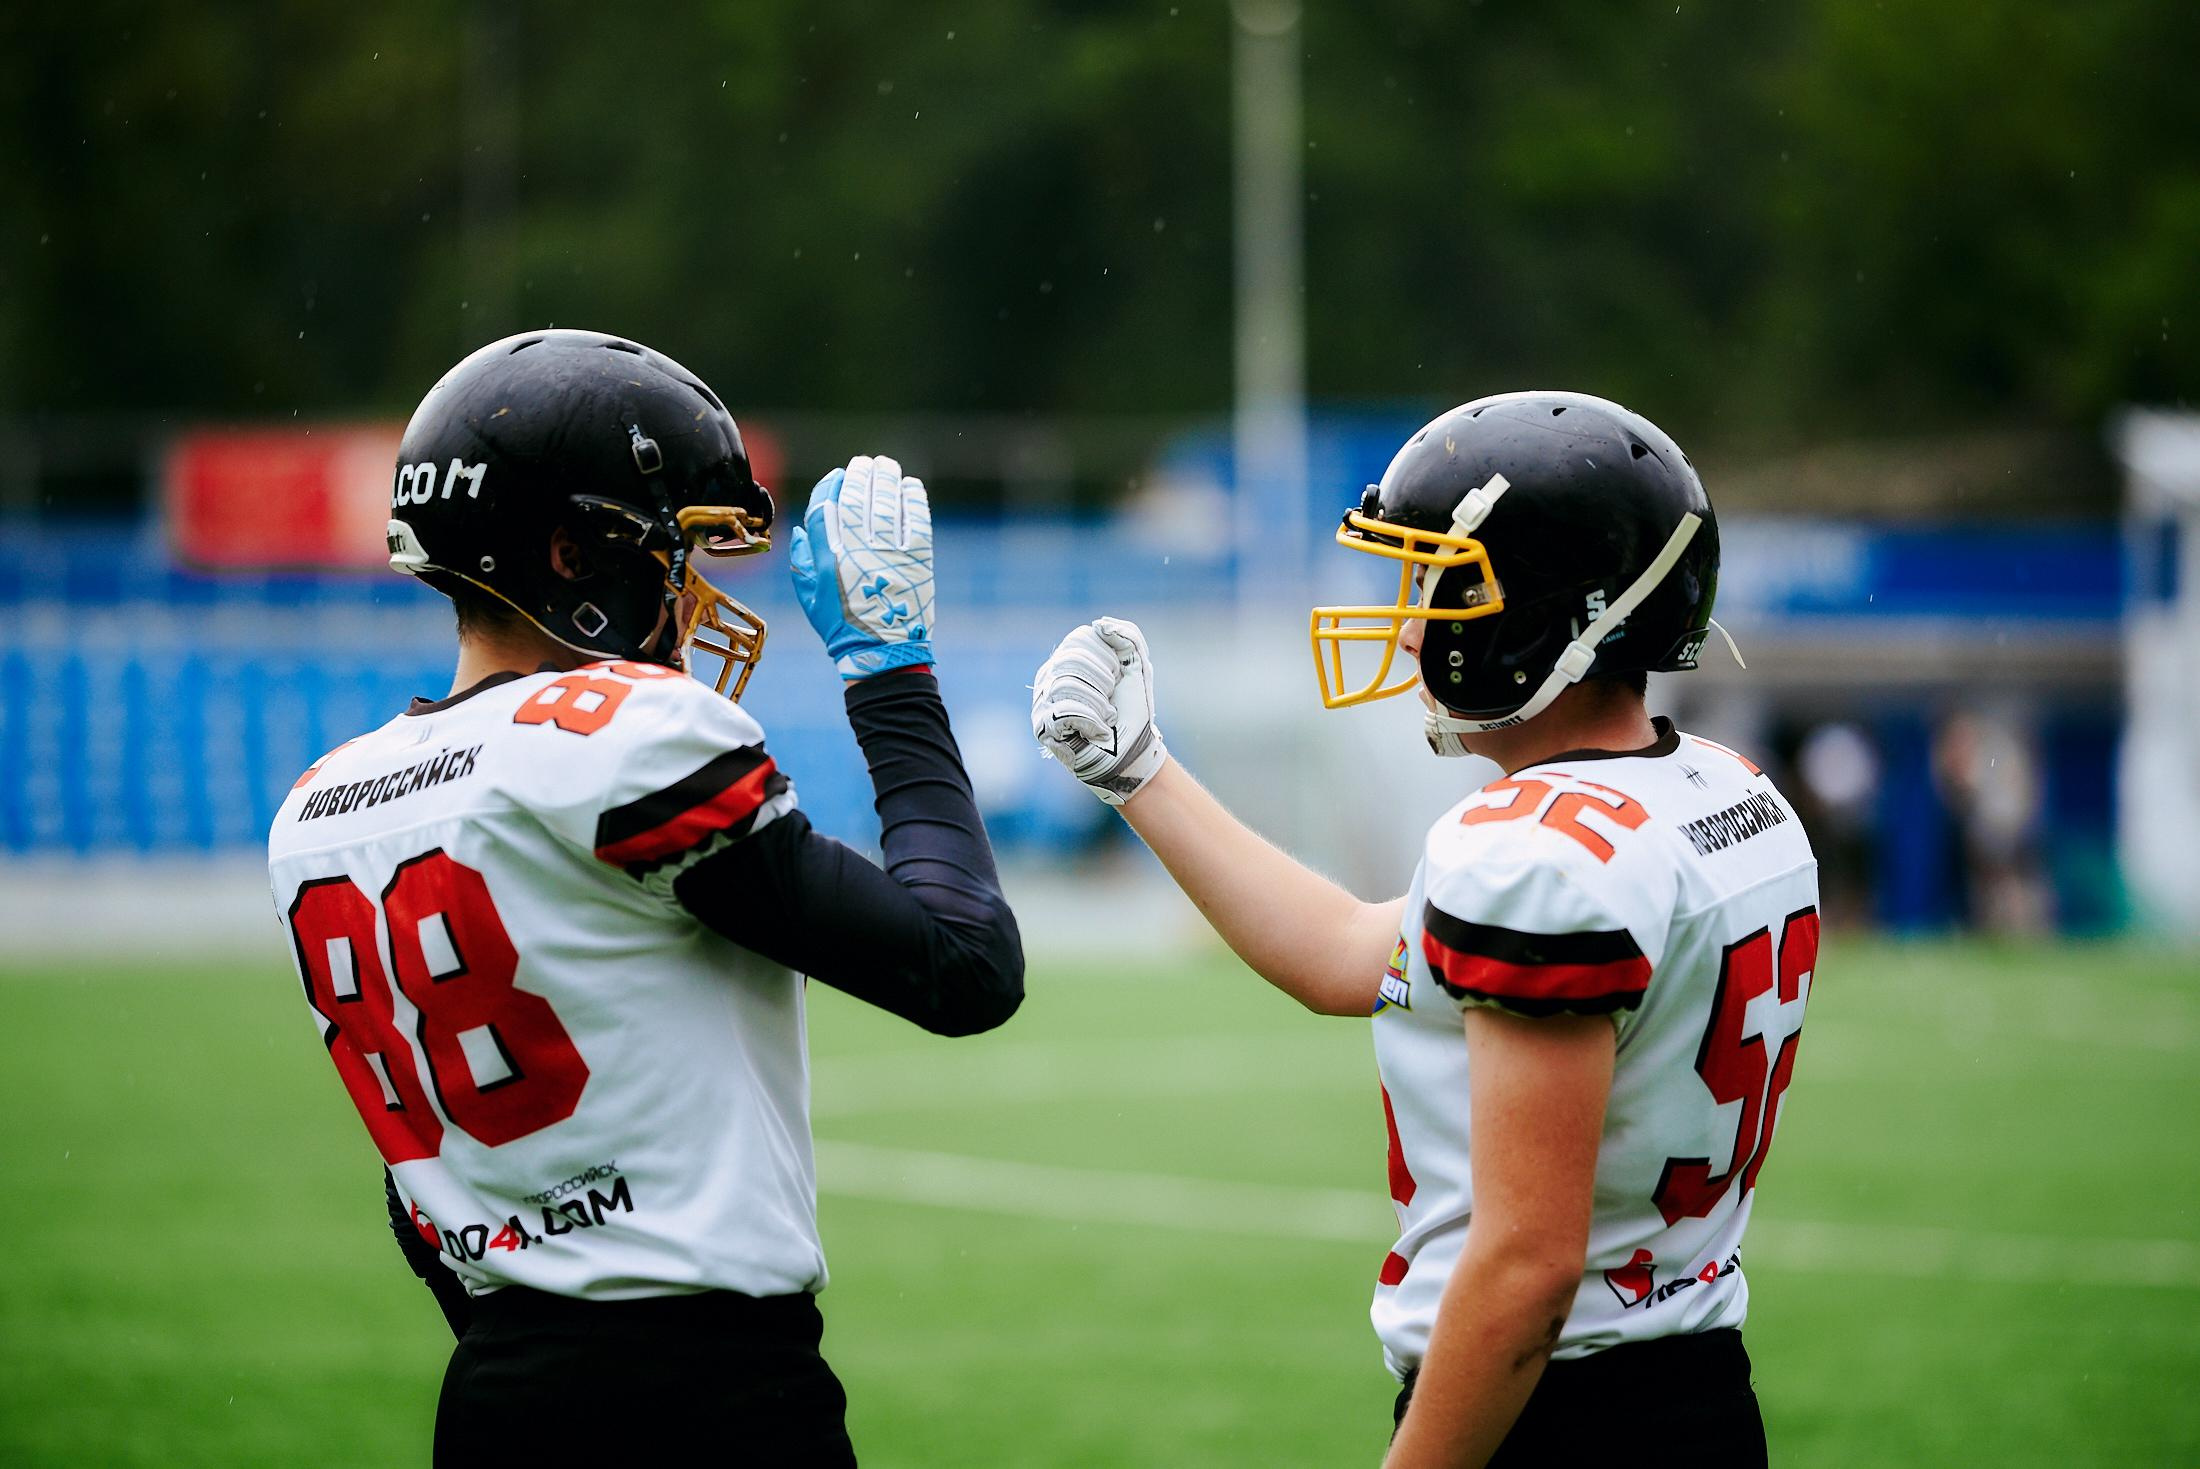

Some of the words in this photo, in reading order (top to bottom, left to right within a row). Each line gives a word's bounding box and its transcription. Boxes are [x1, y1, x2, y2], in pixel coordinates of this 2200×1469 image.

[297, 743, 485, 823] НОВОРОССИЙСК
[1459, 772, 1652, 865] 52
[1677, 788, 1788, 857] НОВОРОССИЙСК
[287, 846, 591, 1166] 88
[1650, 904, 1821, 1229] 52
